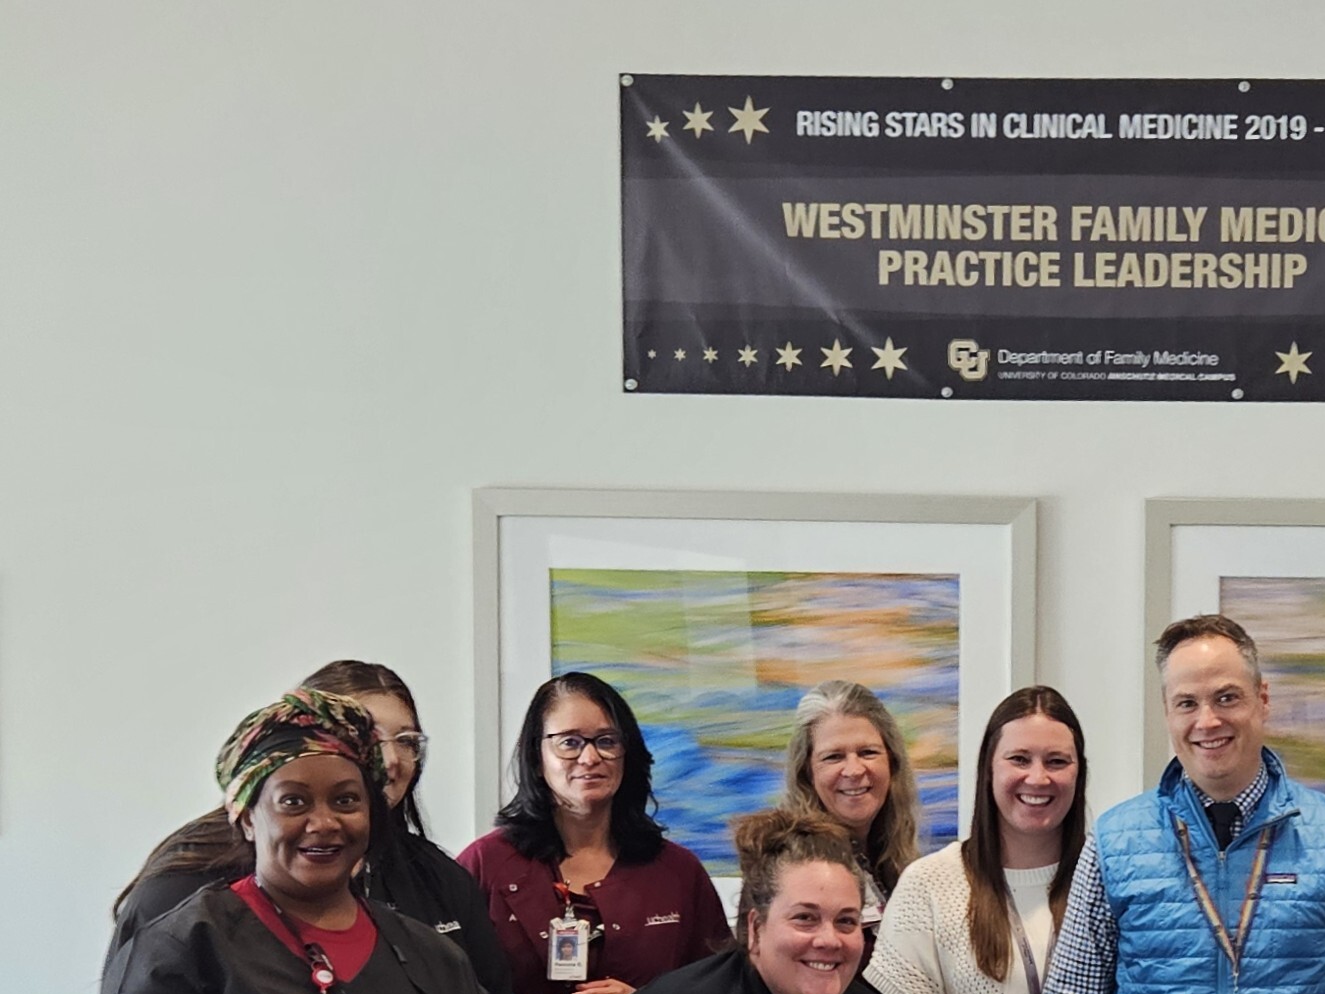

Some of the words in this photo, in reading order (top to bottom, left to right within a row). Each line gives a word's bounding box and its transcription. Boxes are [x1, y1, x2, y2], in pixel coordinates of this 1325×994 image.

[796, 110, 880, 138] RISING
[885, 111, 965, 139] STARS
[970, 112, 997, 139] IN
[1002, 112, 1113, 140] CLINICAL
[1118, 113, 1238, 140] MEDICINE
[1245, 114, 1308, 141] 2019
[782, 202, 1057, 242] WESTMINSTER
[1070, 205, 1208, 242] FAMILY
[878, 250, 1061, 288] PRACTICE
[1073, 252, 1308, 290] LEADERSHIP
[997, 349, 1084, 367] Department
[1086, 350, 1103, 365] of
[1104, 350, 1152, 368] Family
[1153, 350, 1220, 366] Medicine
[997, 371, 1046, 380] UNIVERSITY
[1047, 371, 1060, 380] OF
[1060, 371, 1107, 380] COLORADO
